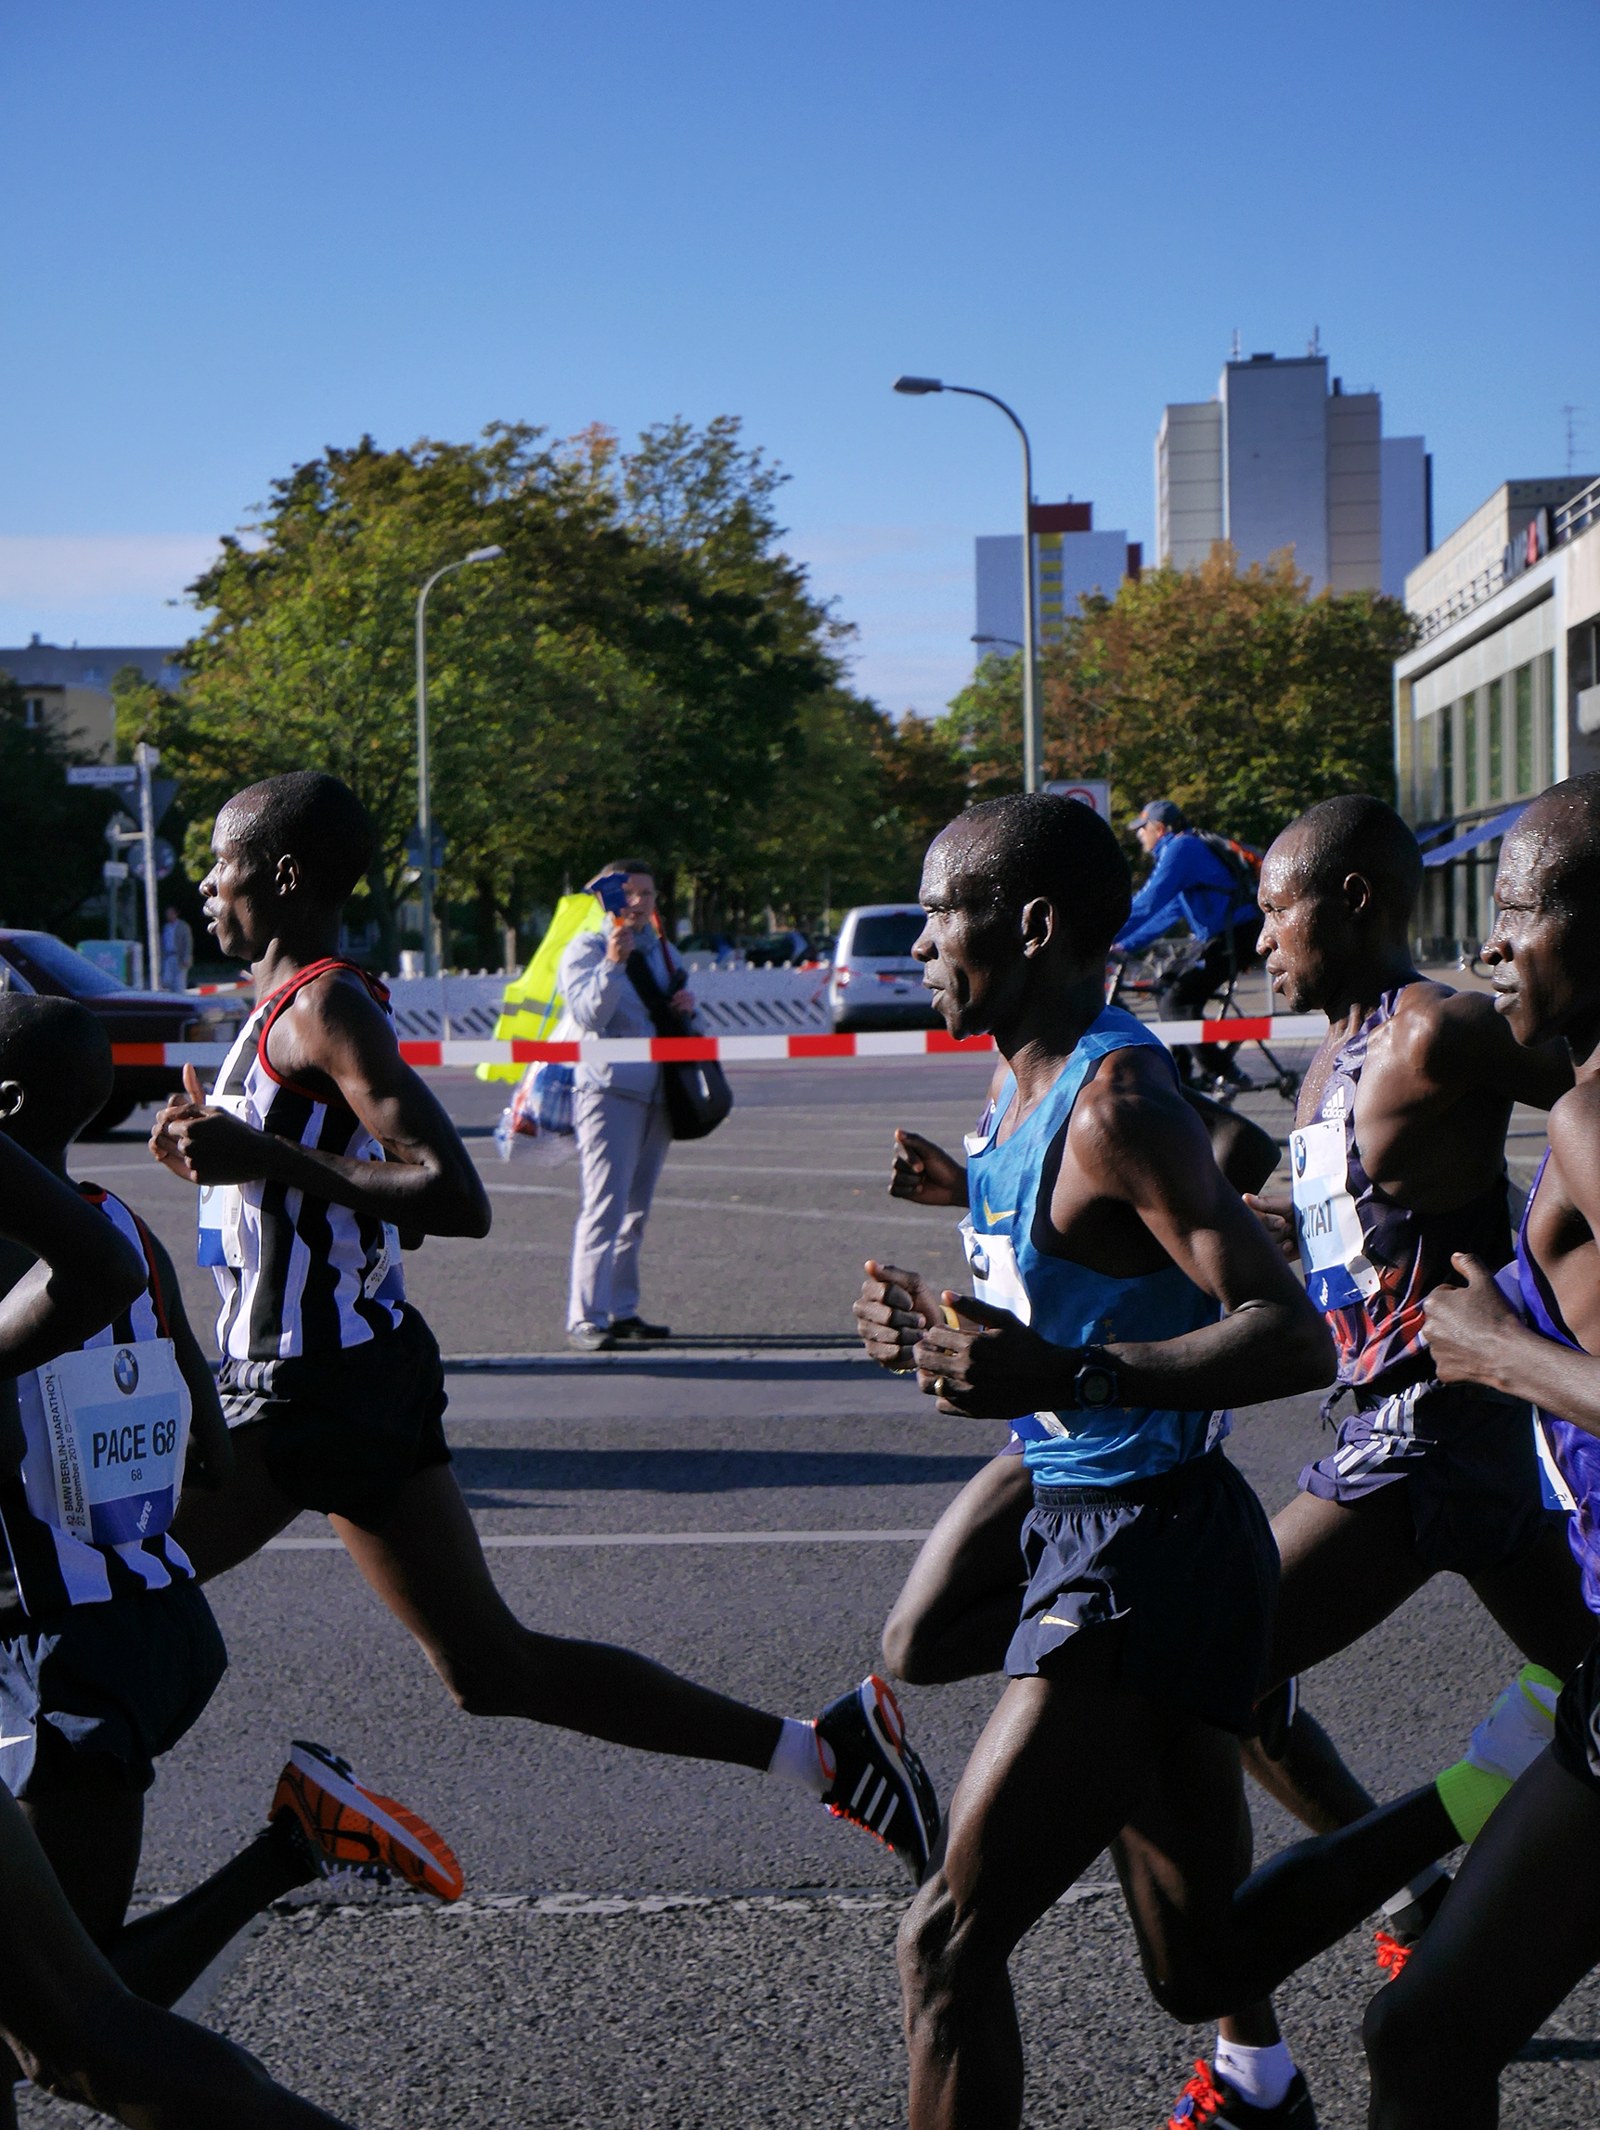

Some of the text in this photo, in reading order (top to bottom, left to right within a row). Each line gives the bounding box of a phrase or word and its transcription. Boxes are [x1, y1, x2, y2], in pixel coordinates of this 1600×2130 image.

[1321, 1107, 1347, 1119] adidas
[44, 1374, 71, 1484] BERLIN-MARATHON
[66, 1437, 78, 1461] 2015
[93, 1419, 177, 1469] PACE 68
[72, 1462, 84, 1513] September
[131, 1468, 142, 1481] 68
[62, 1486, 74, 1512] BMW
